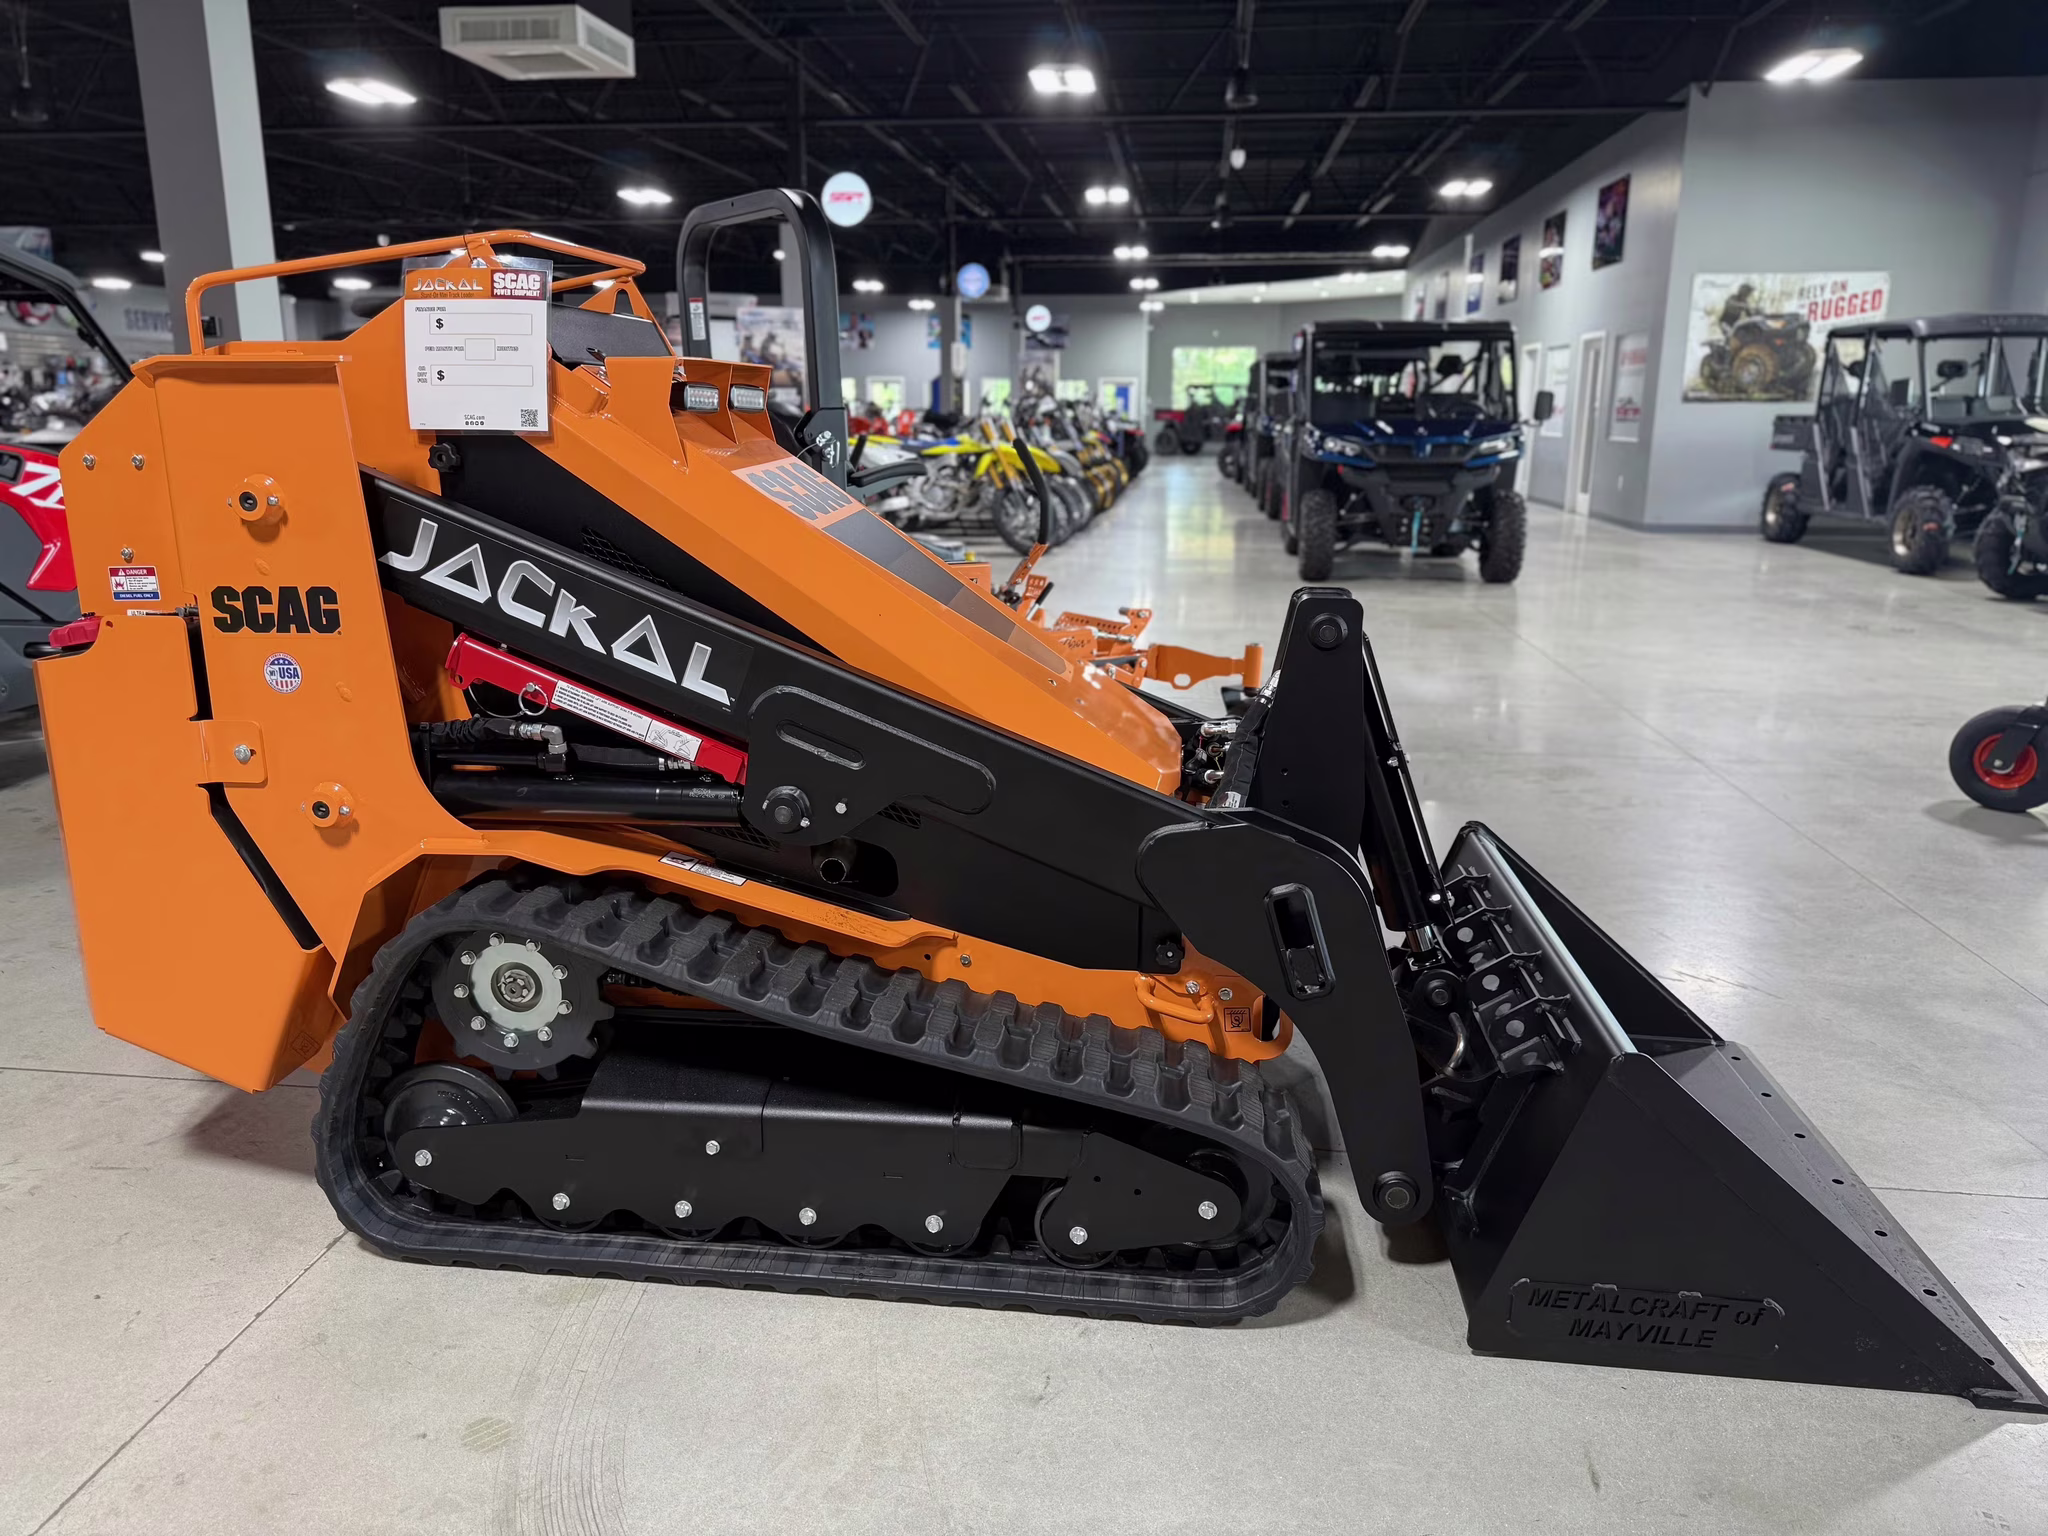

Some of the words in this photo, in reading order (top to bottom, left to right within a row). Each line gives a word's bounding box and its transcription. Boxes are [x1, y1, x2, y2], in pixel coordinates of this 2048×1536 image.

[412, 277, 484, 291] JACKAL
[493, 272, 541, 290] SCAG
[1830, 279, 1849, 295] ON
[511, 289, 541, 297] EQUIPMENT
[1807, 289, 1884, 322] RUGGED
[435, 317, 444, 330] $
[436, 369, 445, 382] $
[210, 586, 341, 633] SCAG
[378, 518, 731, 706] JACKAL
[278, 666, 301, 680] USA
[1528, 1287, 1729, 1323] METALCRAFT
[1734, 1306, 1767, 1326] of
[1568, 1318, 1717, 1349] MAYVILLE
